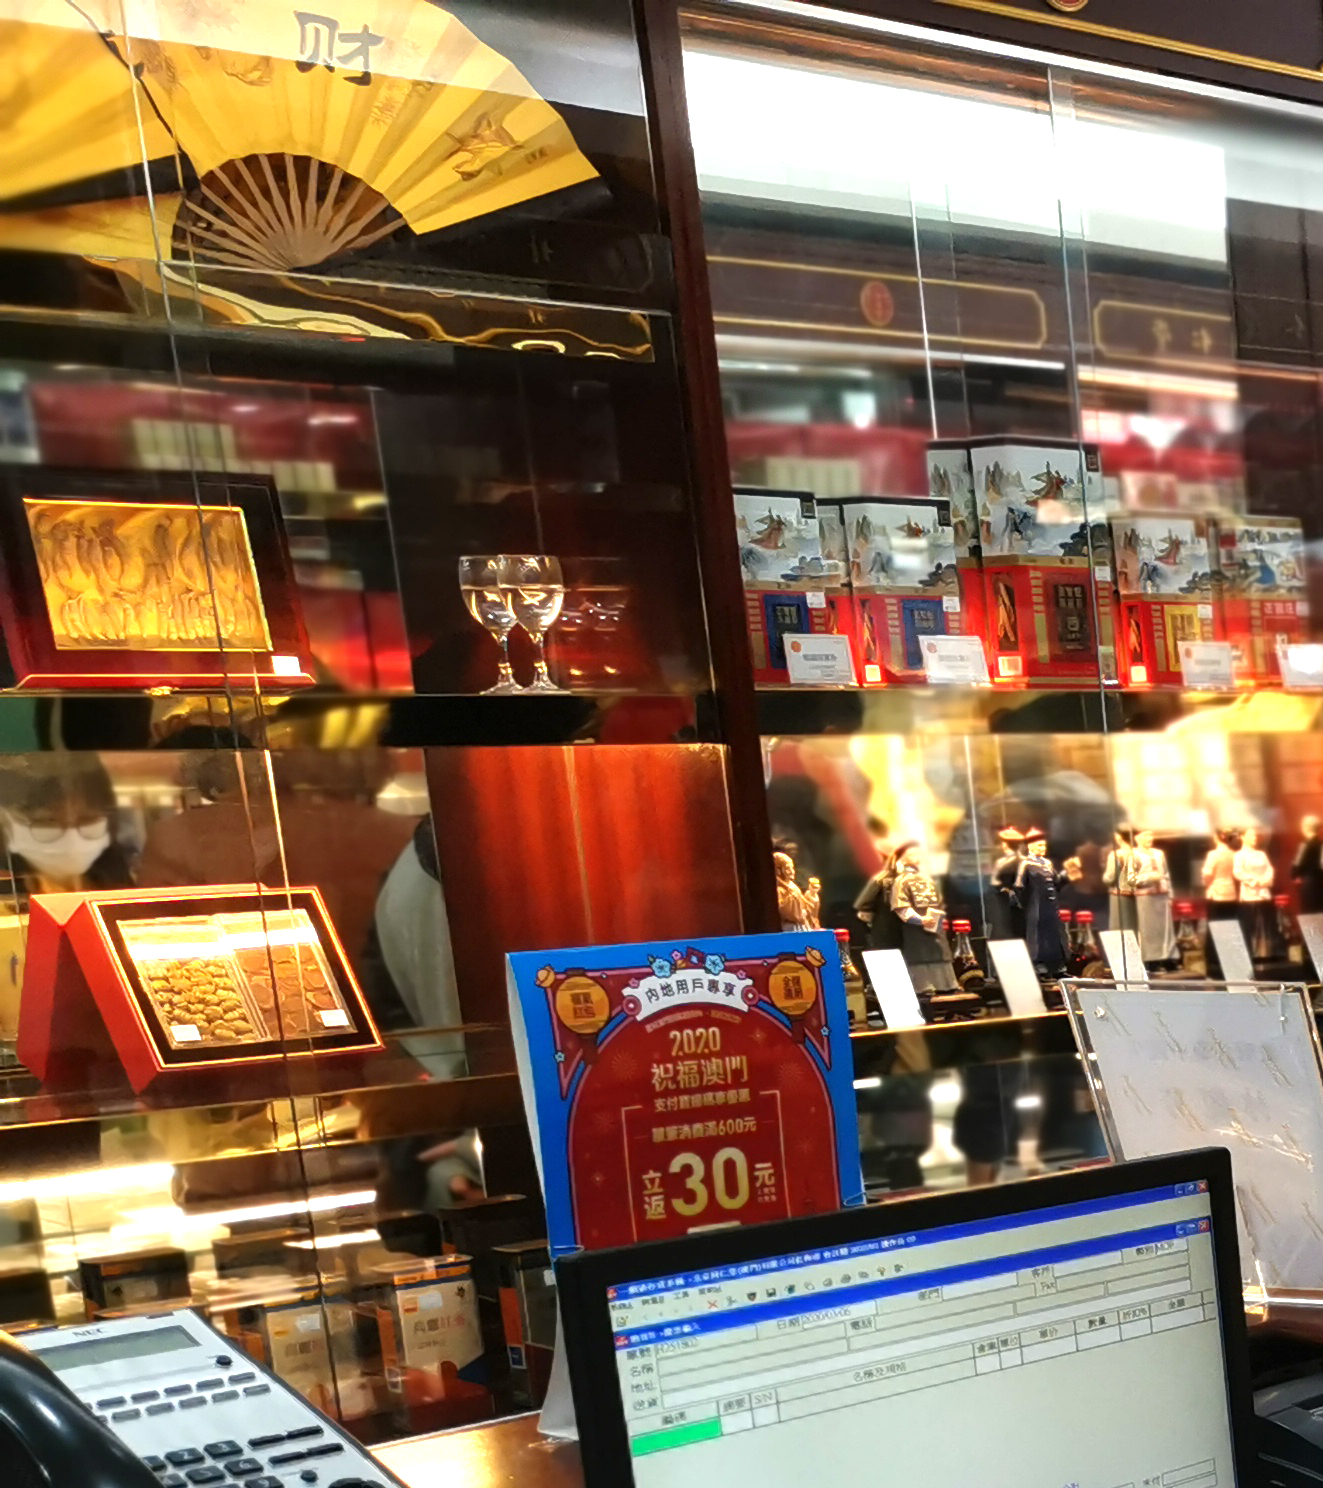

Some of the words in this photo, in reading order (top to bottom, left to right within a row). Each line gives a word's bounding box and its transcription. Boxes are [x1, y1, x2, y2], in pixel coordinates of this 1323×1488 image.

[293, 10, 384, 86] 财
[669, 1026, 721, 1057] 2020
[651, 1055, 749, 1092] 祝福澳門
[642, 1170, 667, 1220] 立返
[668, 1147, 751, 1217] 30
[753, 1162, 776, 1188] 元
[73, 1327, 107, 1338] NEC
